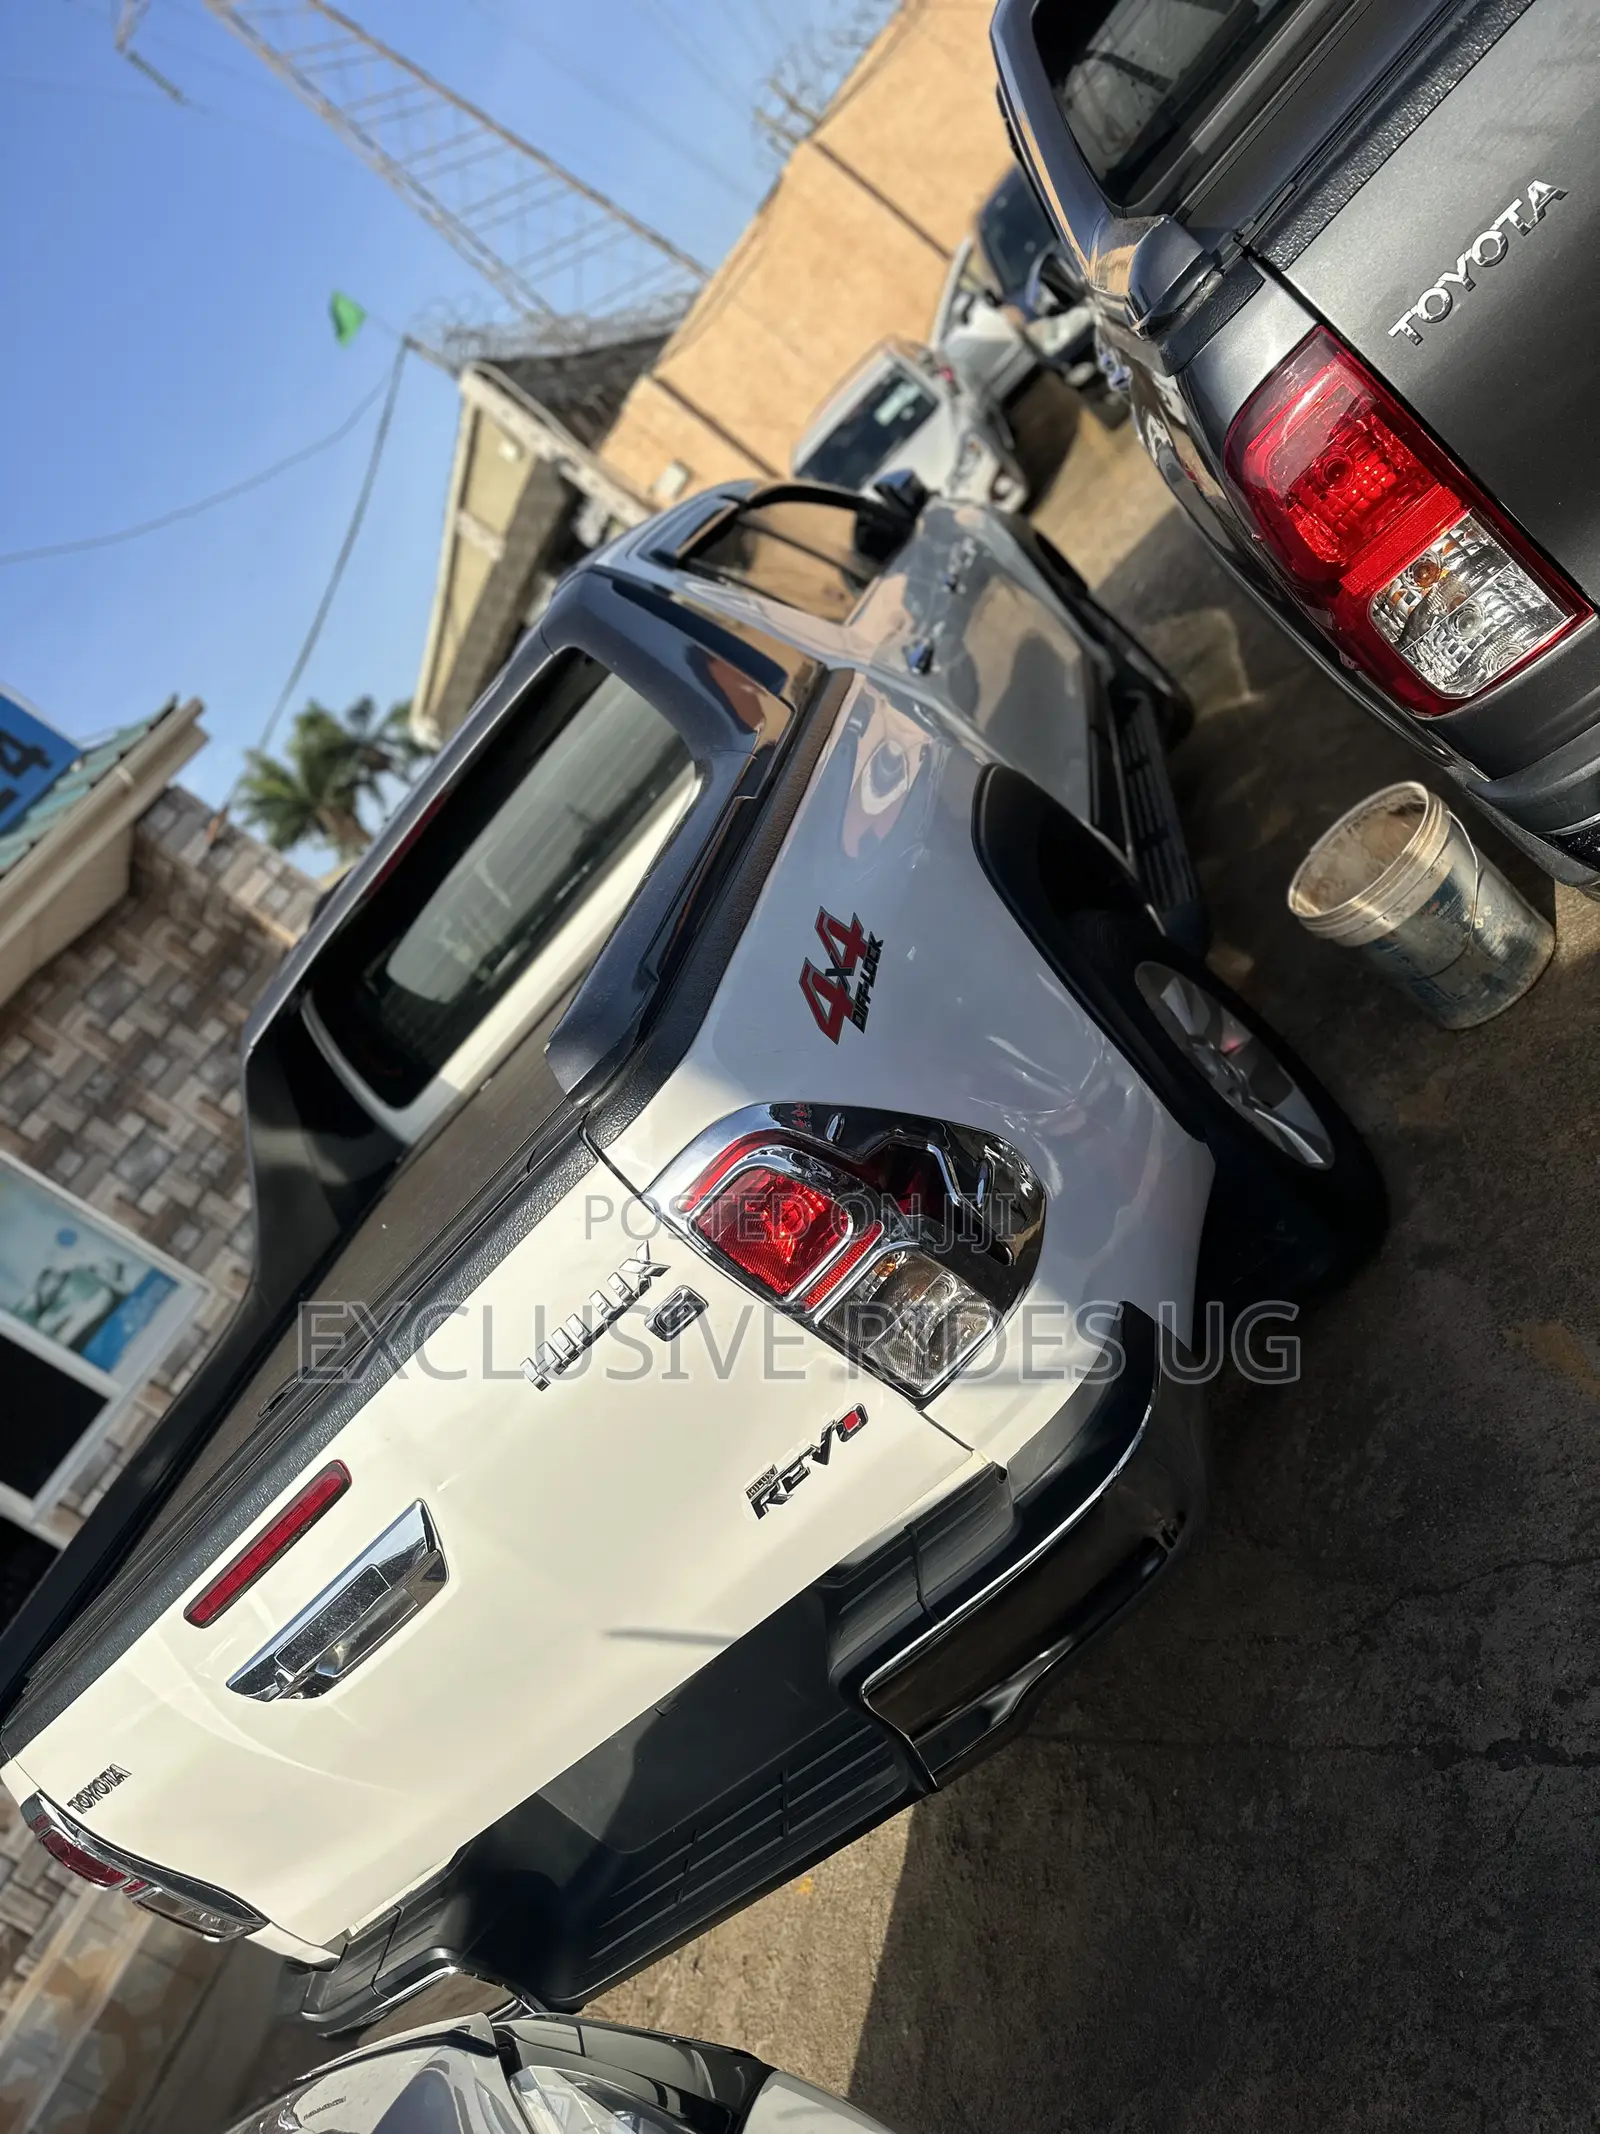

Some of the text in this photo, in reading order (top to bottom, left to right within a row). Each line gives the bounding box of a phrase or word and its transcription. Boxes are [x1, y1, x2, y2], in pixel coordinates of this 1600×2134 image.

[1387, 178, 1569, 346] TOYOTA
[519, 1239, 672, 1392] HILUX
[66, 1763, 132, 1815] TOYOTA
